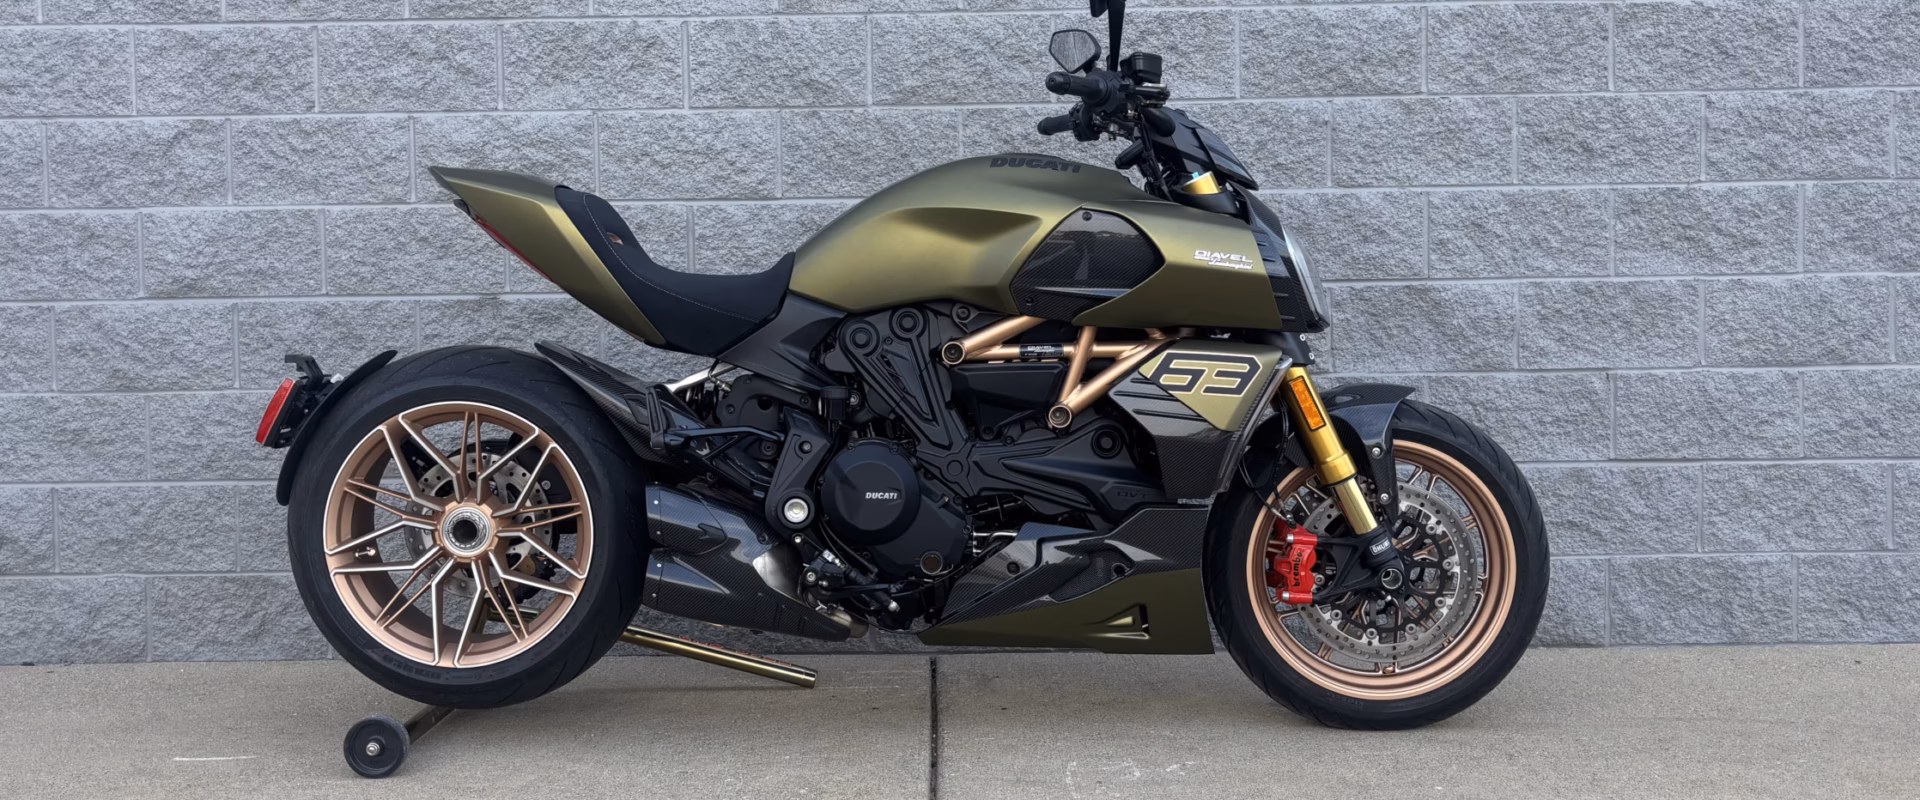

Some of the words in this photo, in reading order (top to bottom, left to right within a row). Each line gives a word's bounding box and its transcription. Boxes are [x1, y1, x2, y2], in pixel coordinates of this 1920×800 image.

[989, 157, 1082, 173] DUCATI
[1194, 249, 1253, 263] DIAVEL
[1148, 350, 1263, 397] 63
[865, 491, 898, 499] DUCATI
[1293, 551, 1303, 587] brembo
